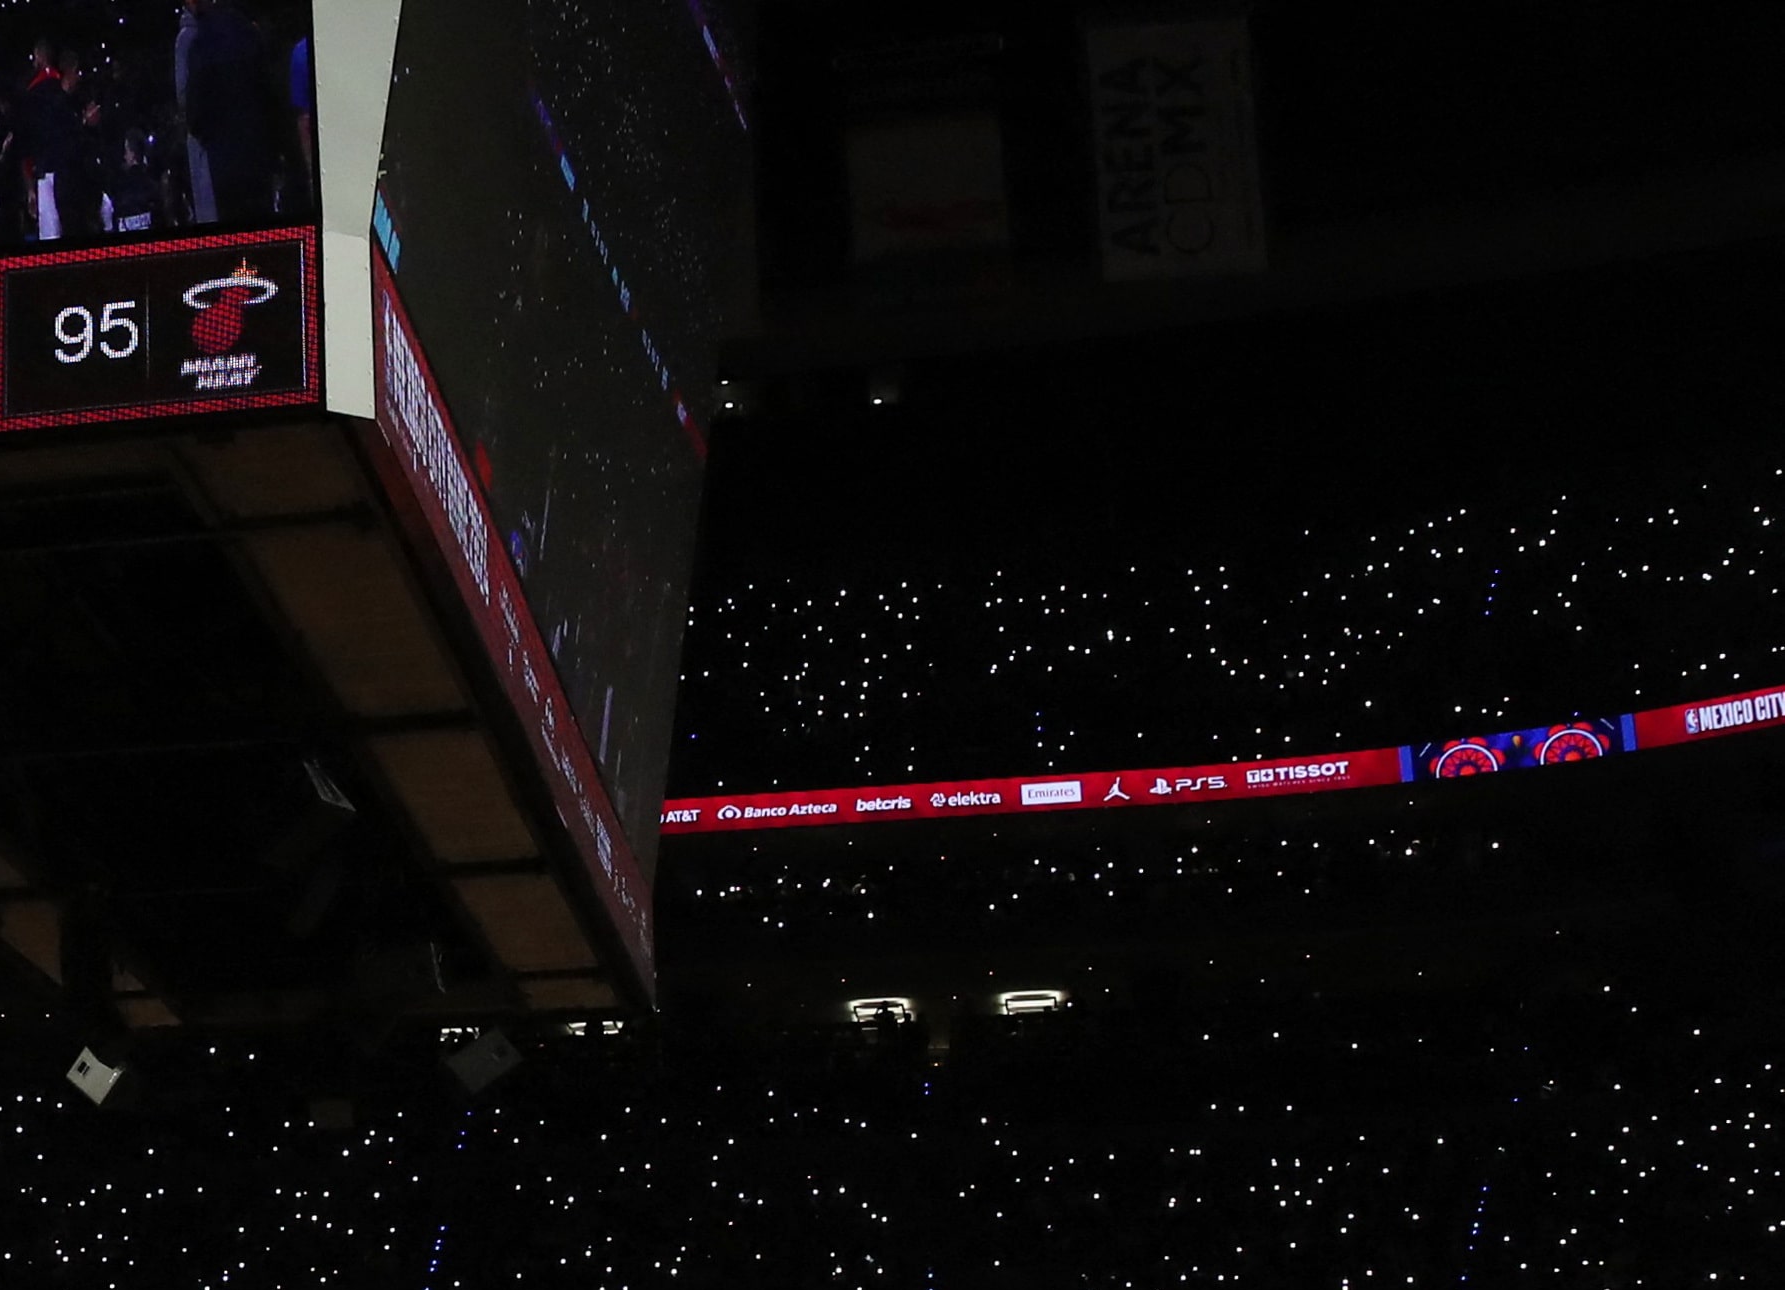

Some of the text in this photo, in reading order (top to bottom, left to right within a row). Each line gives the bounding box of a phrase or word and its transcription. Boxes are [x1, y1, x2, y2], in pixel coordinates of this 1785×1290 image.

[54, 300, 139, 363] 95
[1699, 698, 1753, 731] MEXICO
[1275, 761, 1348, 780] TISSOT
[1176, 776, 1227, 791] PS5
[948, 792, 1001, 806] elektra
[1027, 786, 1075, 798] Emirates
[744, 802, 837, 818] Banco Azteca
[856, 796, 911, 812] betcris
[666, 809, 701, 823] AT&T
